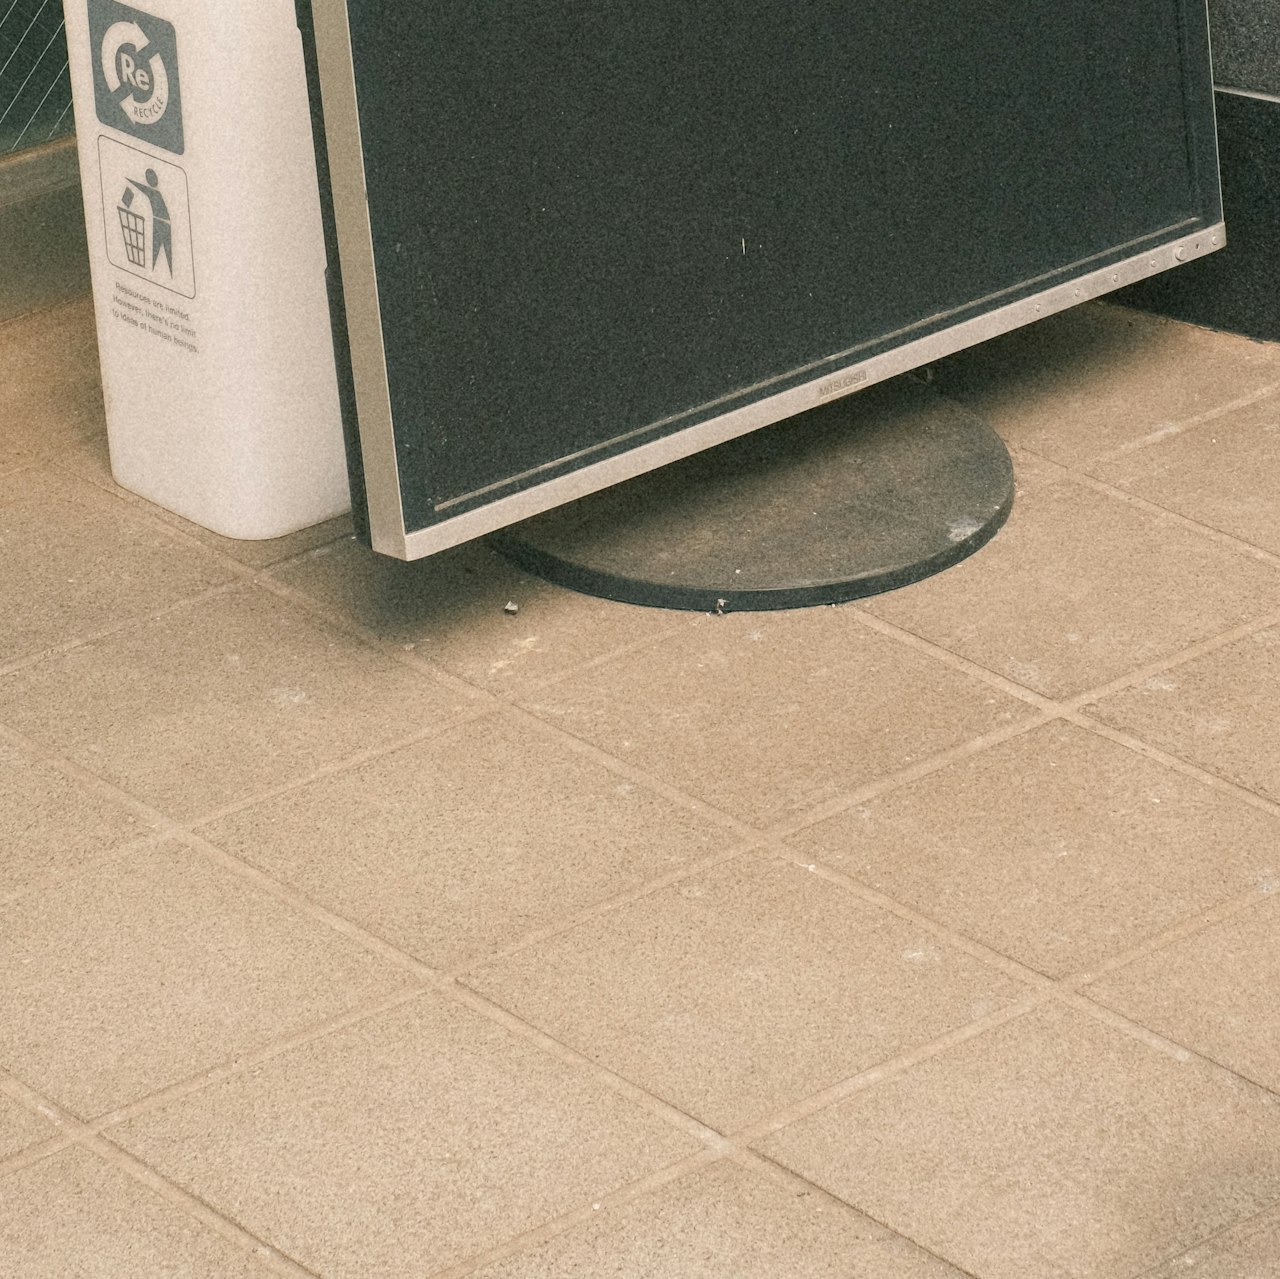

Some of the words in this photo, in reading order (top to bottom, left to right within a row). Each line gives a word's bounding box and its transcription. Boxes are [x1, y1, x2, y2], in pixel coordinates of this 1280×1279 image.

[120, 52, 150, 91] Re
[133, 96, 164, 119] RECYCLE
[115, 281, 151, 305] Resources
[152, 299, 164, 310] are
[113, 294, 144, 317] However,
[170, 322, 180, 331] no
[140, 322, 147, 331] of
[148, 325, 172, 342] human
[818, 370, 868, 396] MITSUBISHI
